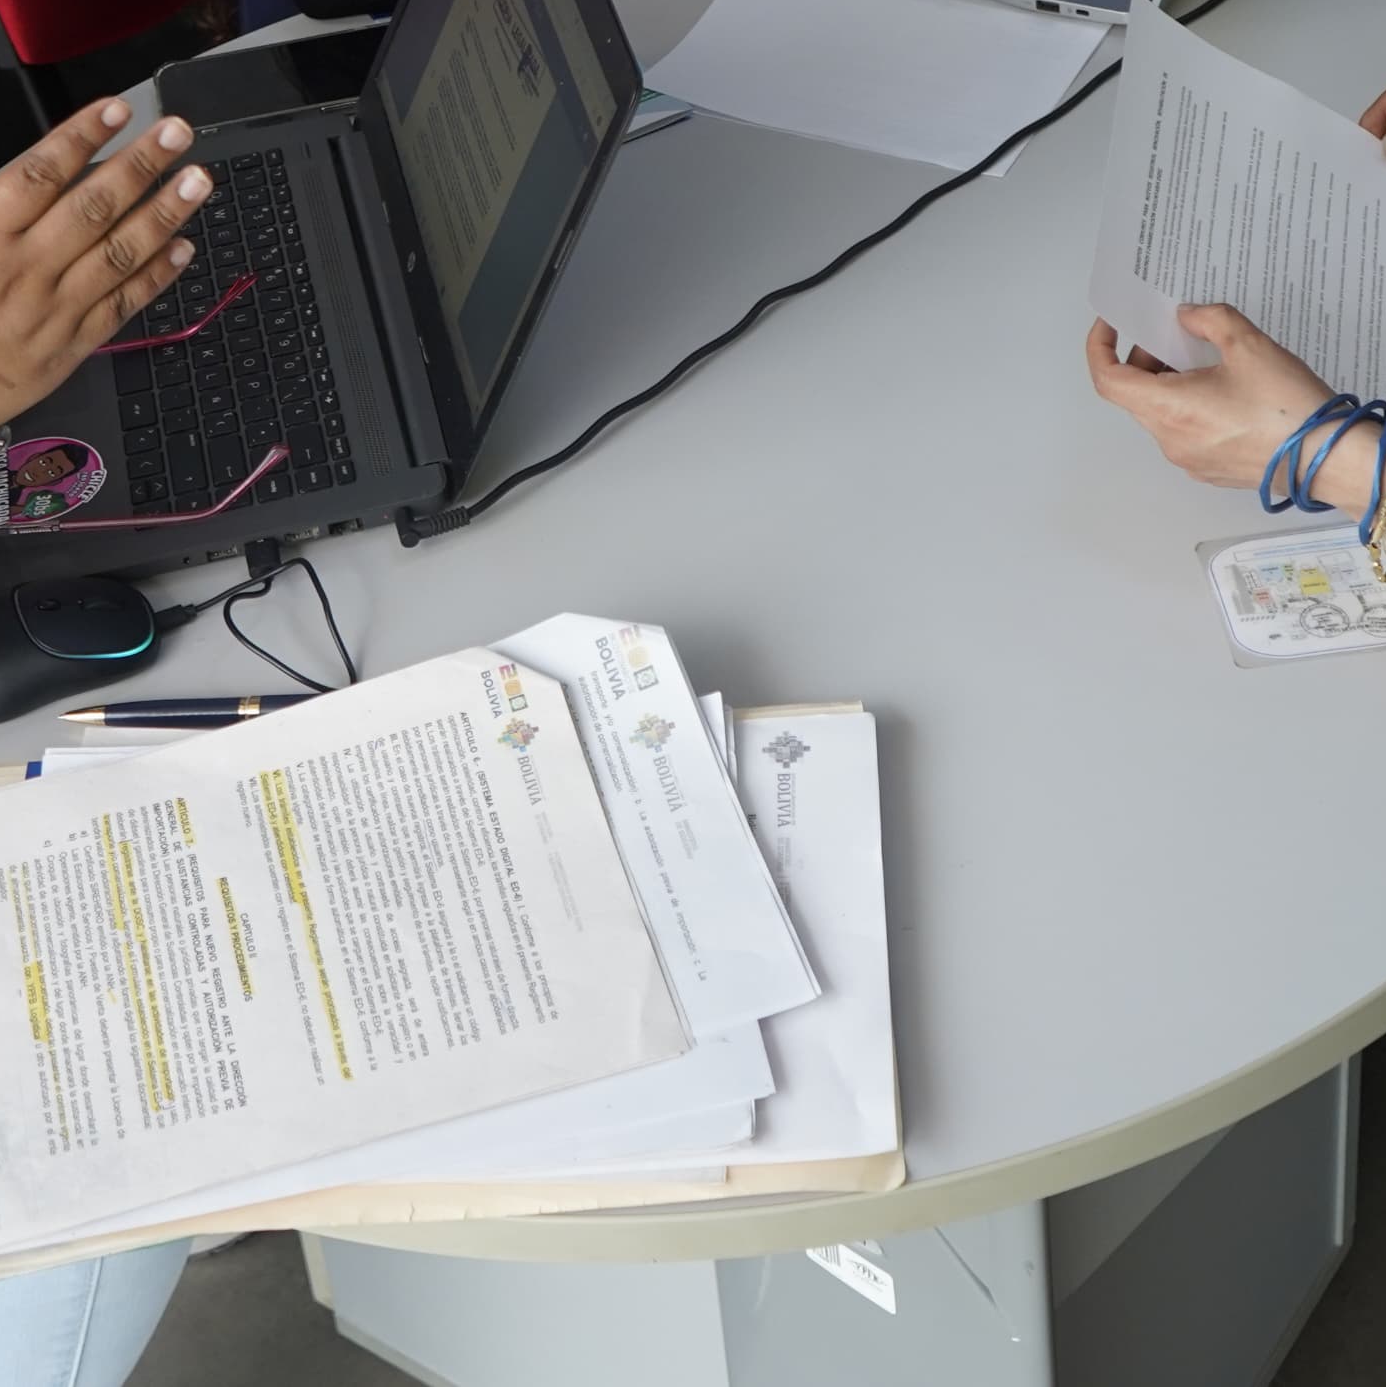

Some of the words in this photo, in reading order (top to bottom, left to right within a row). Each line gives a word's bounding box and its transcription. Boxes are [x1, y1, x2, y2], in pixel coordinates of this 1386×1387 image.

[77, 470, 103, 502] CHICLE
[594, 635, 627, 701] BOLIVIA
[479, 669, 503, 719] BOLIVIA
[458, 709, 479, 754] ARTÍCULO
[474, 768, 495, 809] (SISTEMA
[488, 809, 506, 844] ESTADO
[499, 845, 517, 878] DIGITAL
[516, 754, 544, 806] BOLIVIA
[652, 754, 683, 813] BOLIVIA
[776, 772, 792, 828] BOLIVIA
[150, 801, 171, 858] IMPORTACIÓN)
[177, 795, 192, 835] ARTÍCULO
[186, 851, 206, 903] (REQUISITOS
[199, 905, 211, 929] PARA
[219, 875, 237, 925] REQUISITOS
[230, 929, 253, 1002] PROCEDIMIENTOS
[240, 911, 256, 953] CAPÍTULO
[165, 797, 180, 836] GENERAL
[176, 856, 194, 907] SUSTANCIAS
[187, 911, 207, 973] CONTROLADAS
[202, 989, 223, 1054] AUTORIZACIÓN
[216, 1058, 231, 1092] PREVIA
[204, 932, 218, 963] NUEVO
[211, 966, 228, 1009] REGISTRO
[220, 1013, 233, 1037] ANTE
[230, 1059, 248, 1107] DIRECCIÓN
